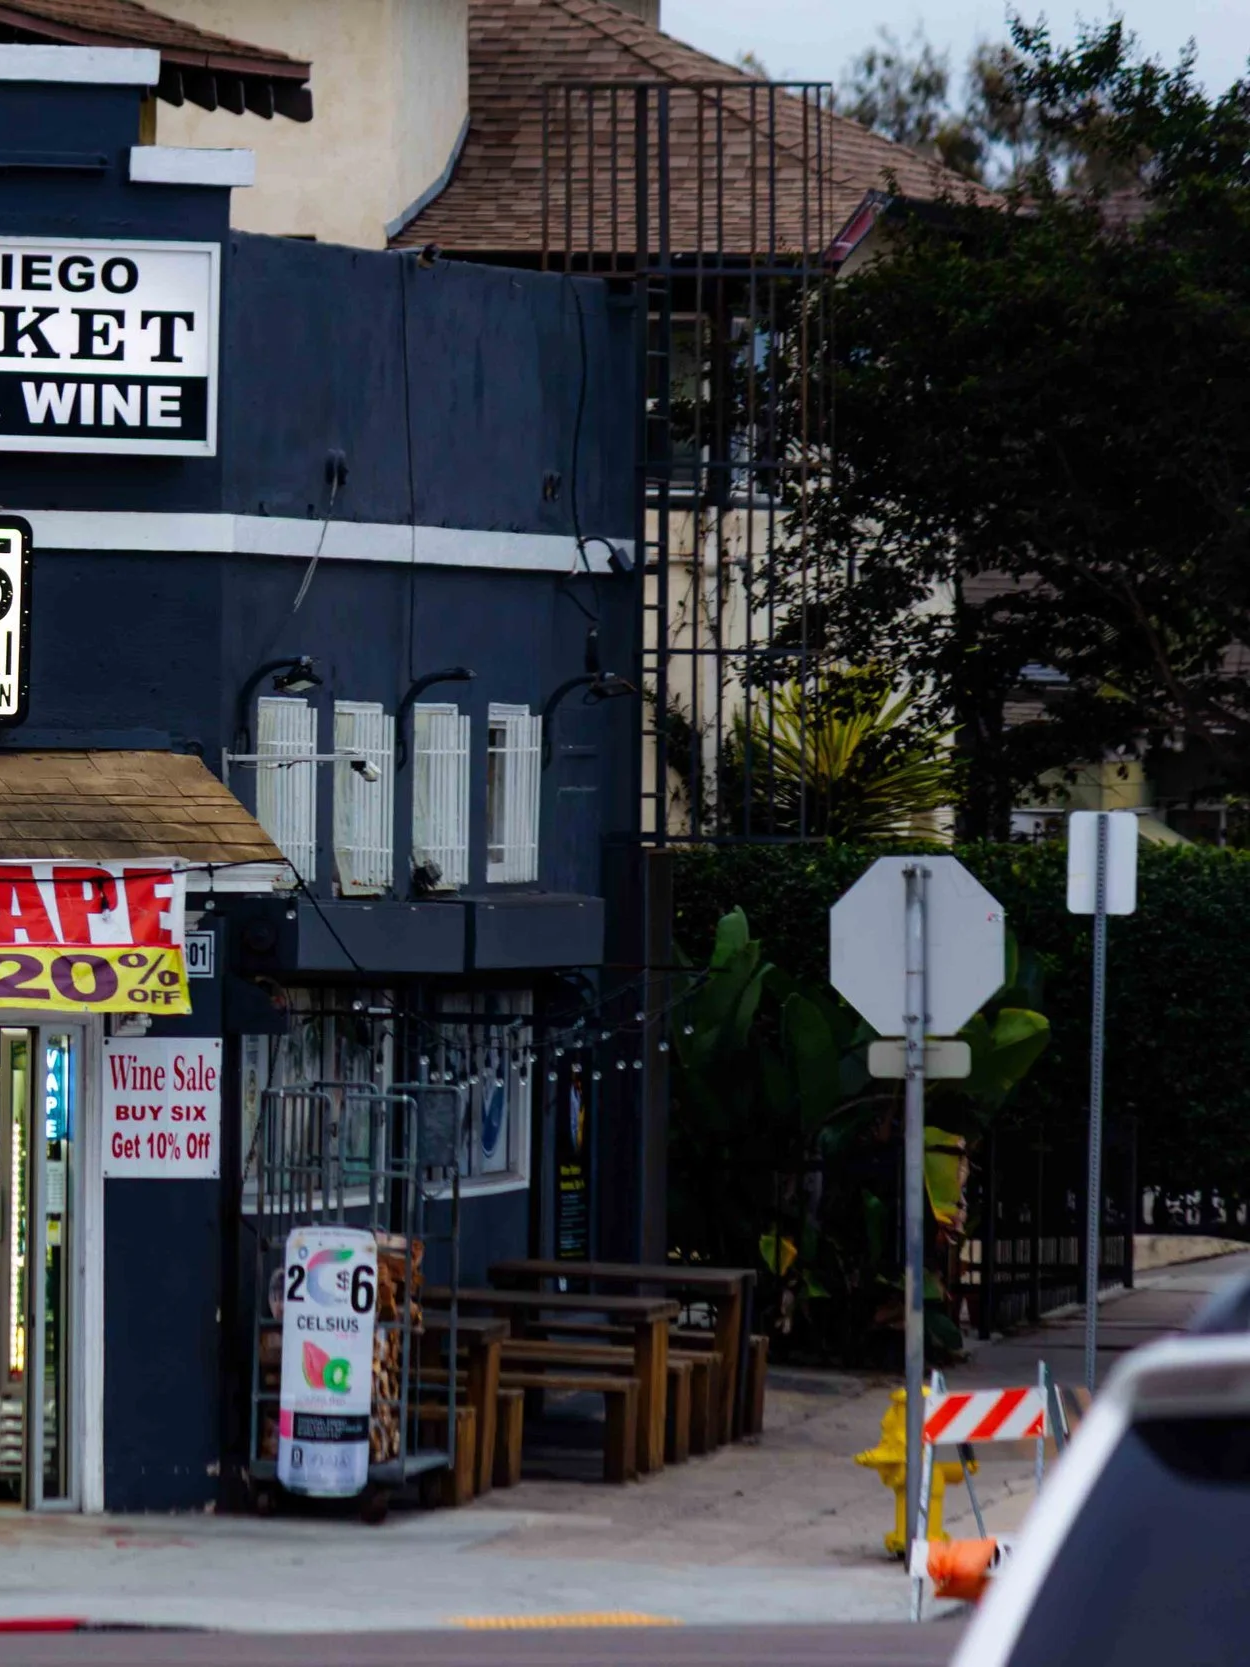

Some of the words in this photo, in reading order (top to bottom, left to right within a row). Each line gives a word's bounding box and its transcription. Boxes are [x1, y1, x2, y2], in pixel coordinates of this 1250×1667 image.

[21, 381, 182, 427] WINE
[127, 989, 182, 1005] OFF
[110, 1054, 166, 1091] Wine
[173, 1054, 216, 1091] Sale
[46, 1048, 59, 1138] VAPE
[116, 1105, 163, 1121] BUY
[171, 1105, 207, 1121] SIX
[112, 1132, 141, 1159] Get
[147, 1132, 181, 1160] 10%
[187, 1132, 211, 1159] Off
[287, 1264, 305, 1302] 2
[297, 1314, 359, 1333] CELSIUS
